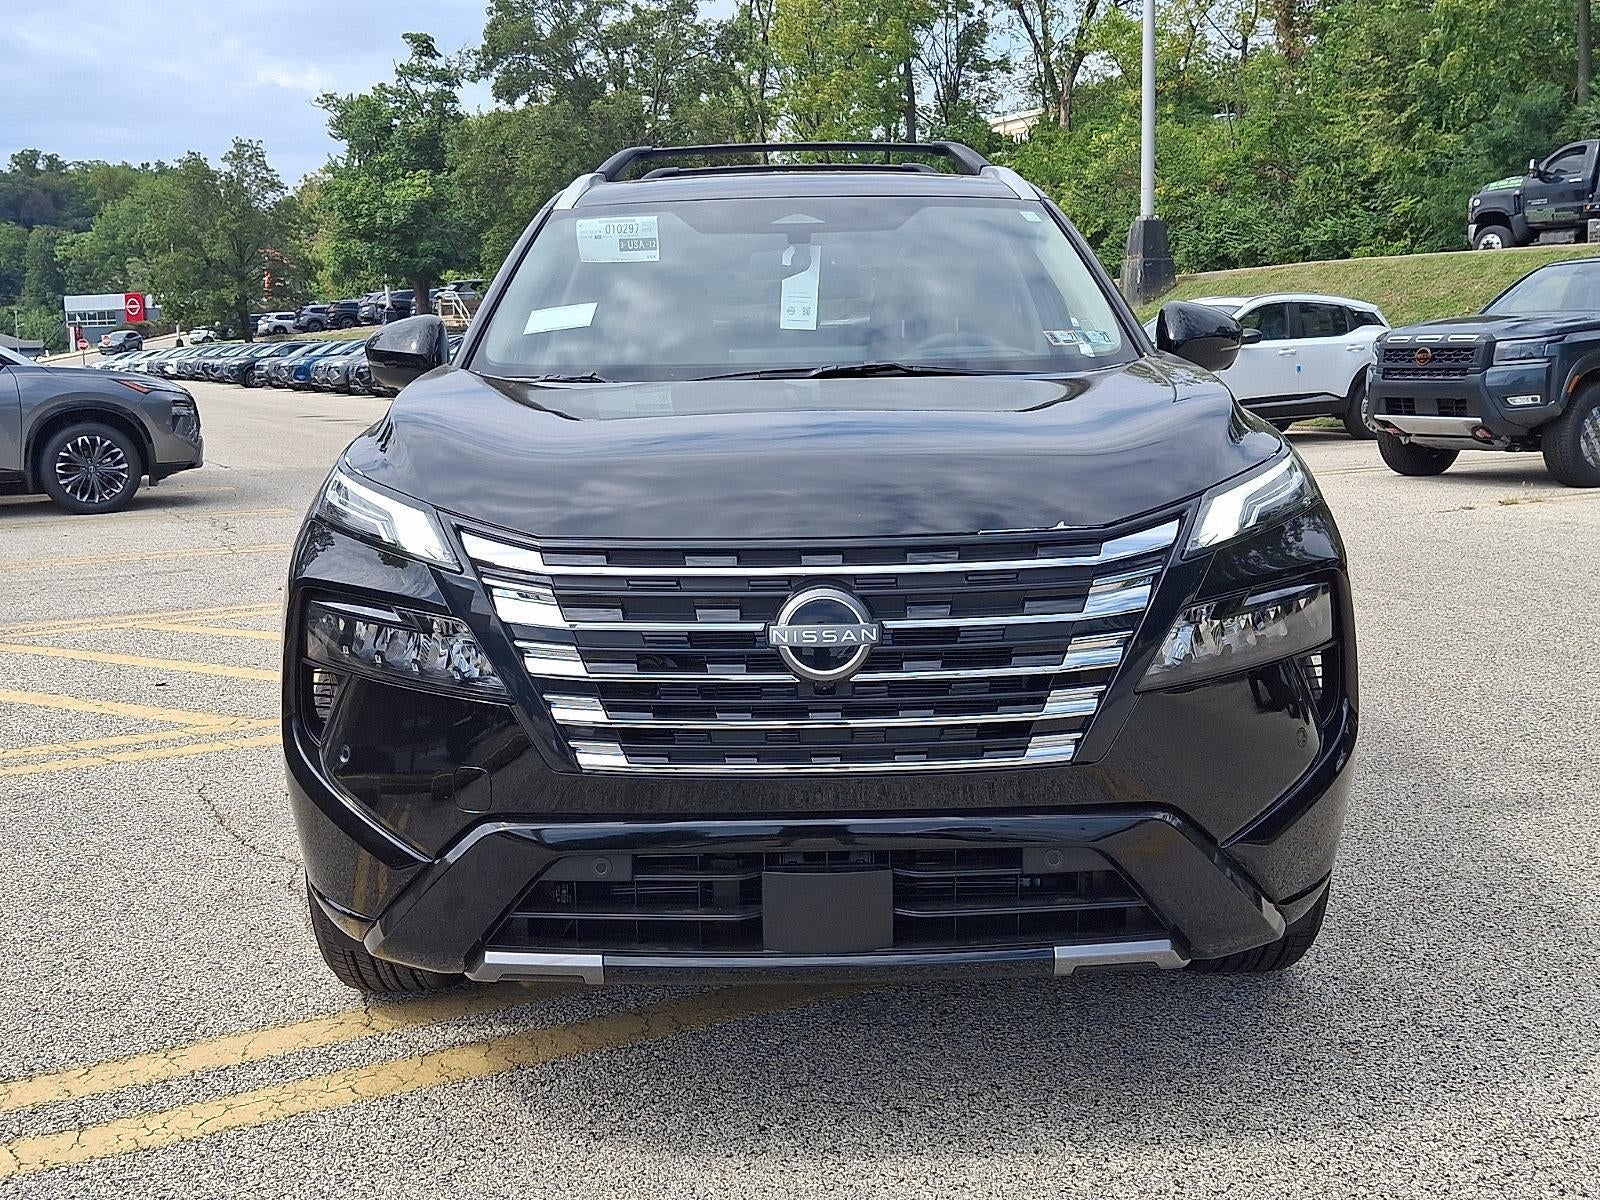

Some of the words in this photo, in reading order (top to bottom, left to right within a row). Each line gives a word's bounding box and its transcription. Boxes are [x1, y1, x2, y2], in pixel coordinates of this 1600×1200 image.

[605, 223, 640, 235] 010297
[627, 240, 645, 249] USA
[772, 627, 877, 643] NISSAN
